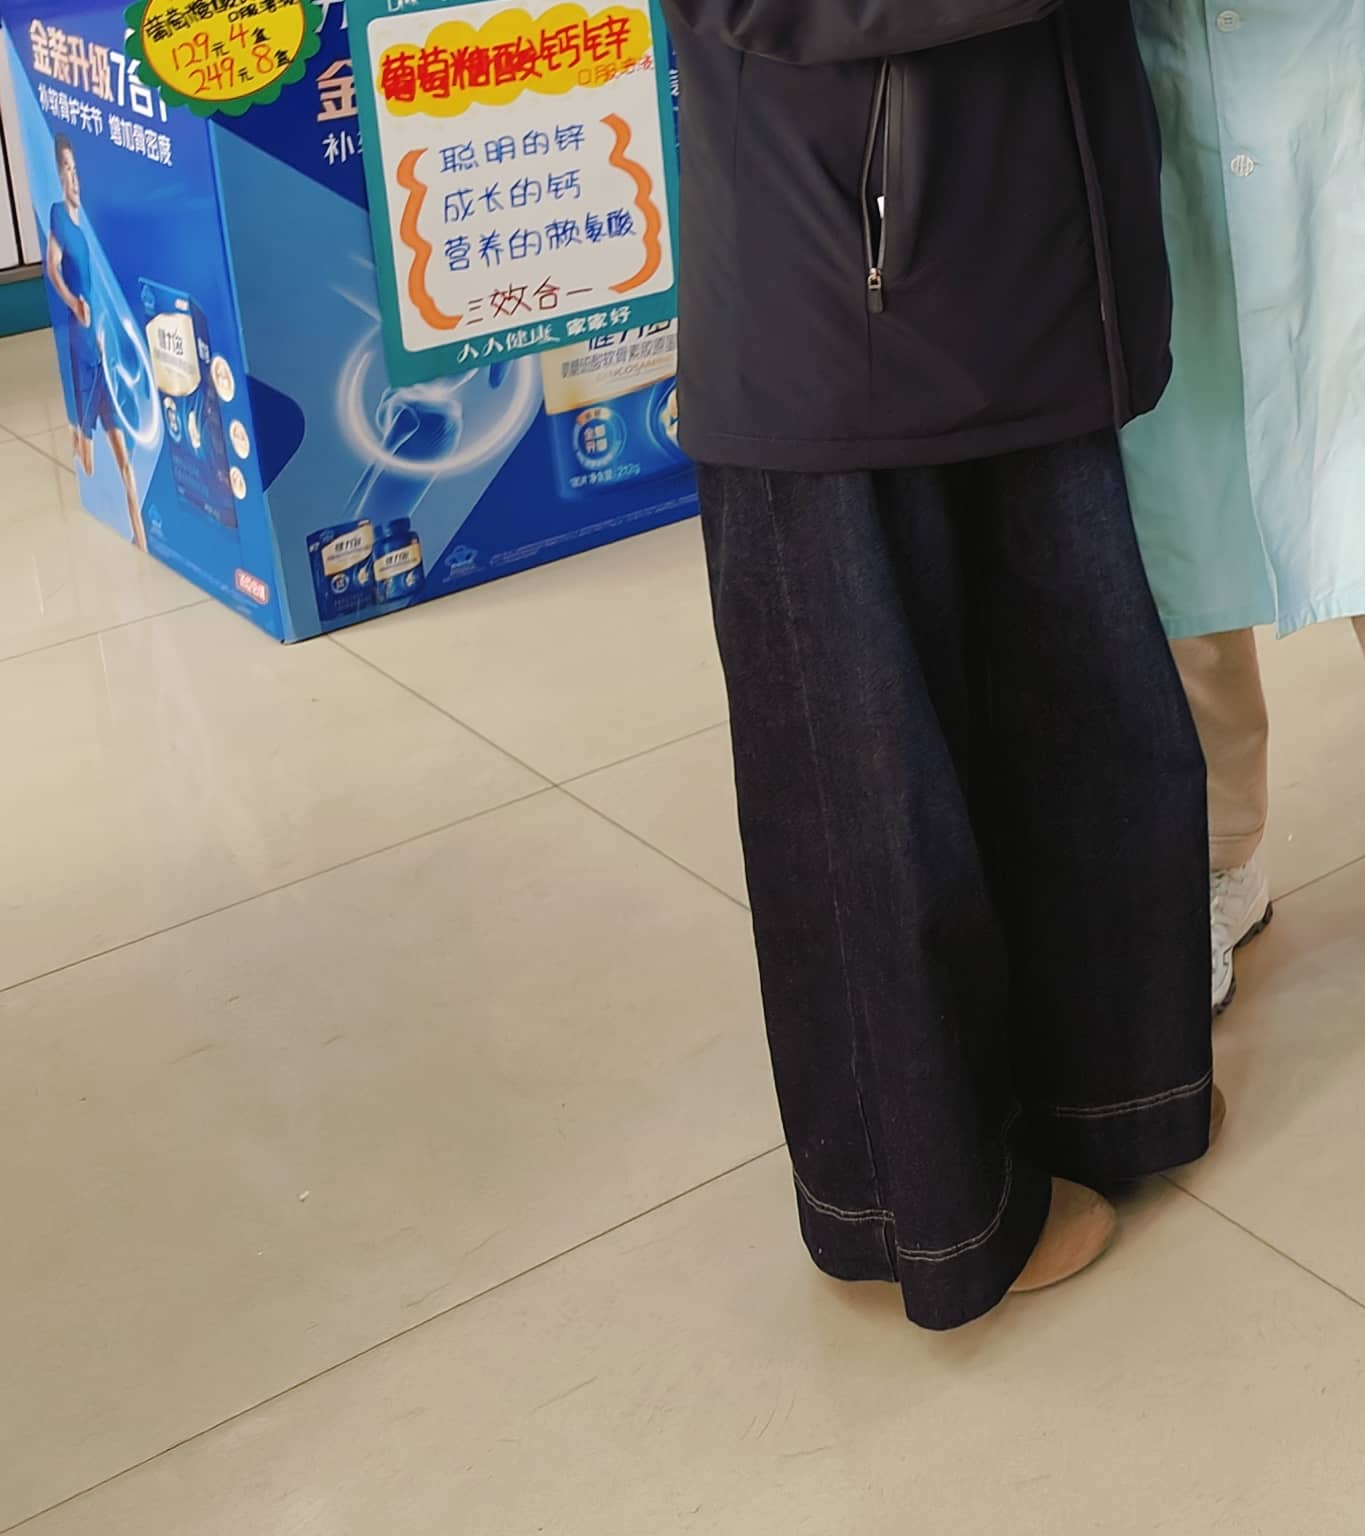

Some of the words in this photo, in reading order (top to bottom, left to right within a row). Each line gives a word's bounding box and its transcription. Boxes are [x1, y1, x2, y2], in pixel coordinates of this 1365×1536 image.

[380, 14, 631, 102] 葡萄糖酸钙锌
[107, 113, 173, 167] 增加骨密度
[438, 123, 586, 174] 聪明的锌
[442, 168, 583, 224] 成长的钙
[442, 206, 637, 273] 营养的赖氨酸
[465, 275, 594, 328] 三效合一
[456, 323, 562, 365] 人人健康
[565, 304, 633, 338] 家家好
